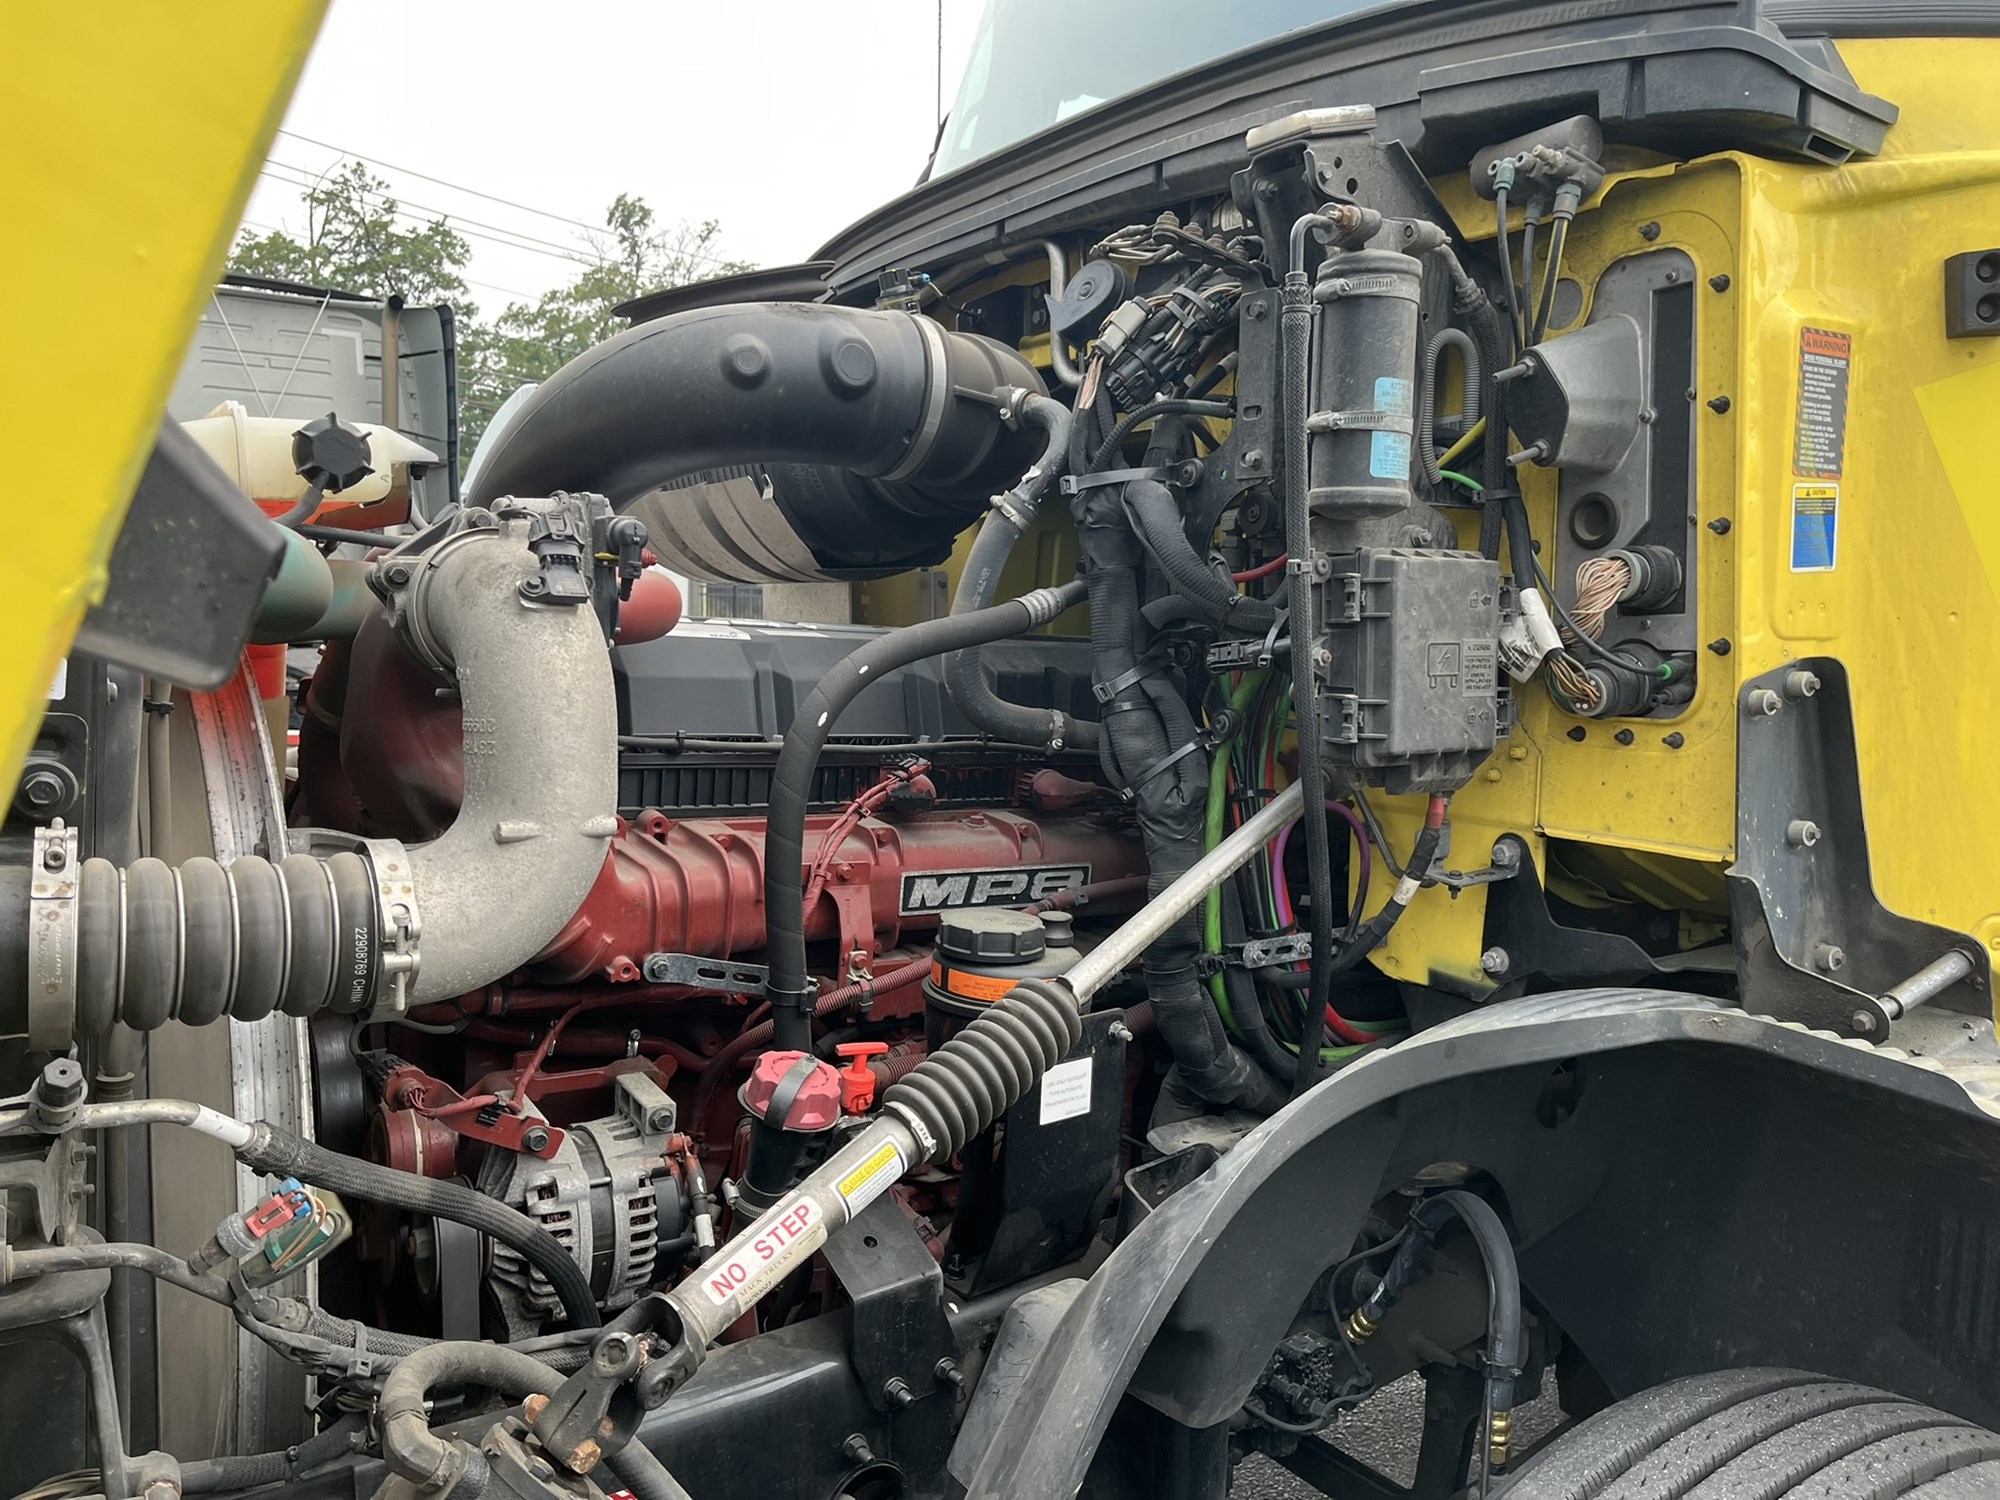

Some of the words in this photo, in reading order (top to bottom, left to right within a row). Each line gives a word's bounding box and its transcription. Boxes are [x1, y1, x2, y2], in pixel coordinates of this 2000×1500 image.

[1812, 338, 1847, 353] WARNING
[908, 870, 1084, 909] MP8
[354, 927, 368, 975] 22908769
[350, 979, 366, 1003] CHINA
[872, 1146, 895, 1167] GARDE
[710, 1263, 747, 1298] NO
[753, 1204, 810, 1260] STEP
[740, 1279, 762, 1297] MACK
[764, 1252, 793, 1277] TRUCKS
